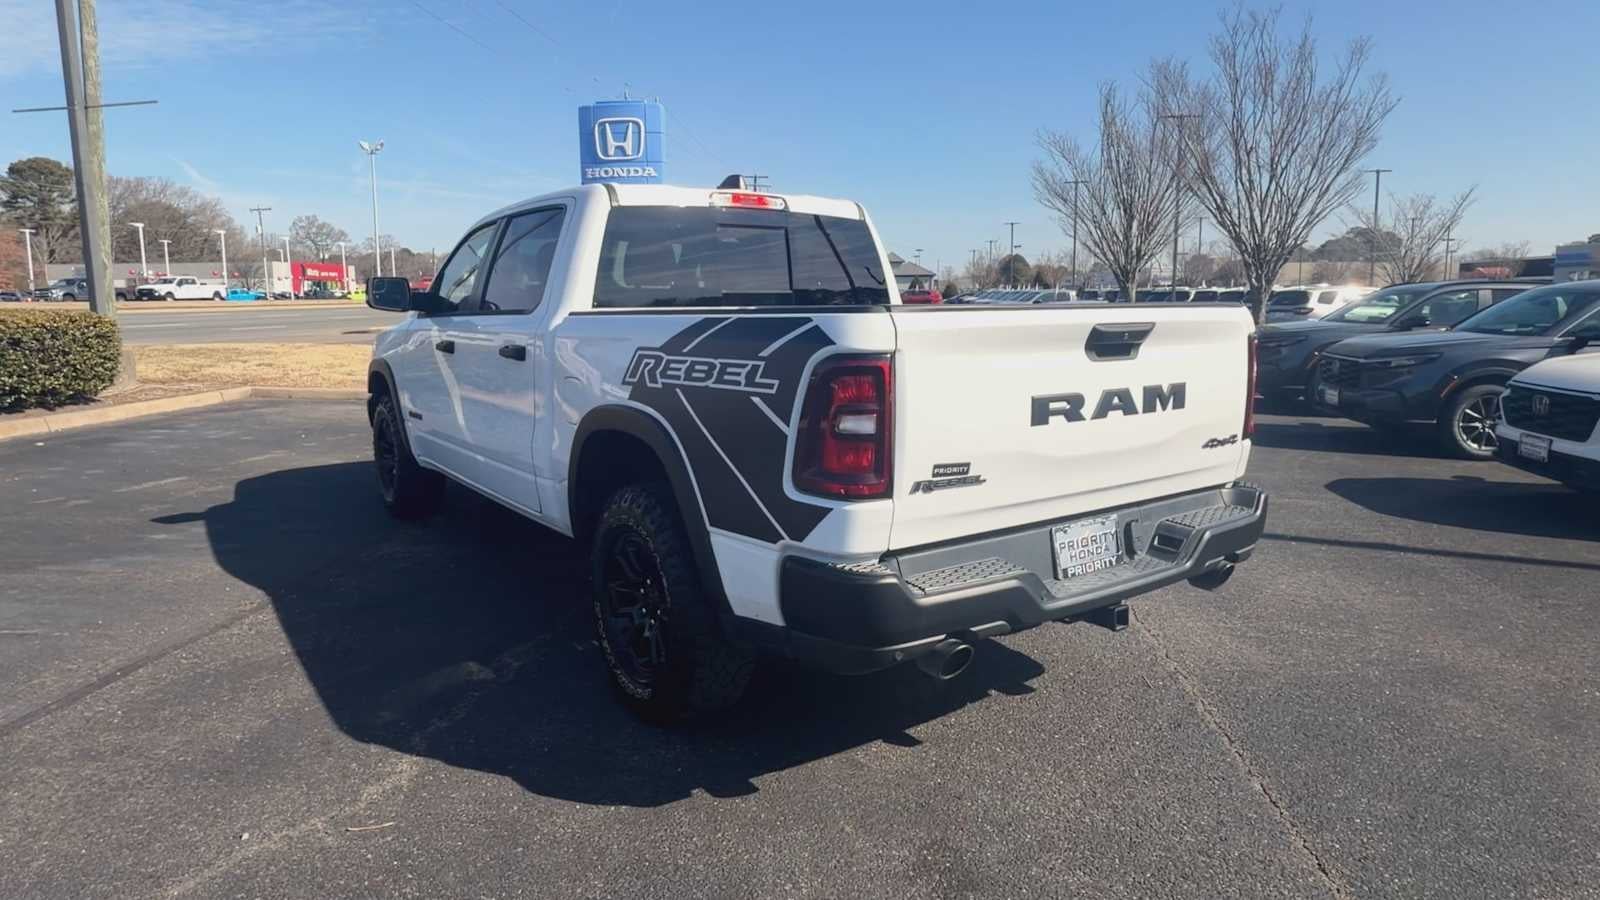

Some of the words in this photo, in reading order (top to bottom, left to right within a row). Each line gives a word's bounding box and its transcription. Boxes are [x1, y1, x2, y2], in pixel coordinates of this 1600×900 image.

[585, 167, 657, 178] HONDA
[624, 350, 780, 394] REBEL
[1030, 382, 1187, 427] RAM
[934, 466, 969, 474] PRIORITY
[908, 474, 987, 496] REBEL
[1058, 529, 1117, 552] PRIORITY
[1069, 544, 1111, 562] HONDA
[1067, 556, 1117, 578] PRIORITY
